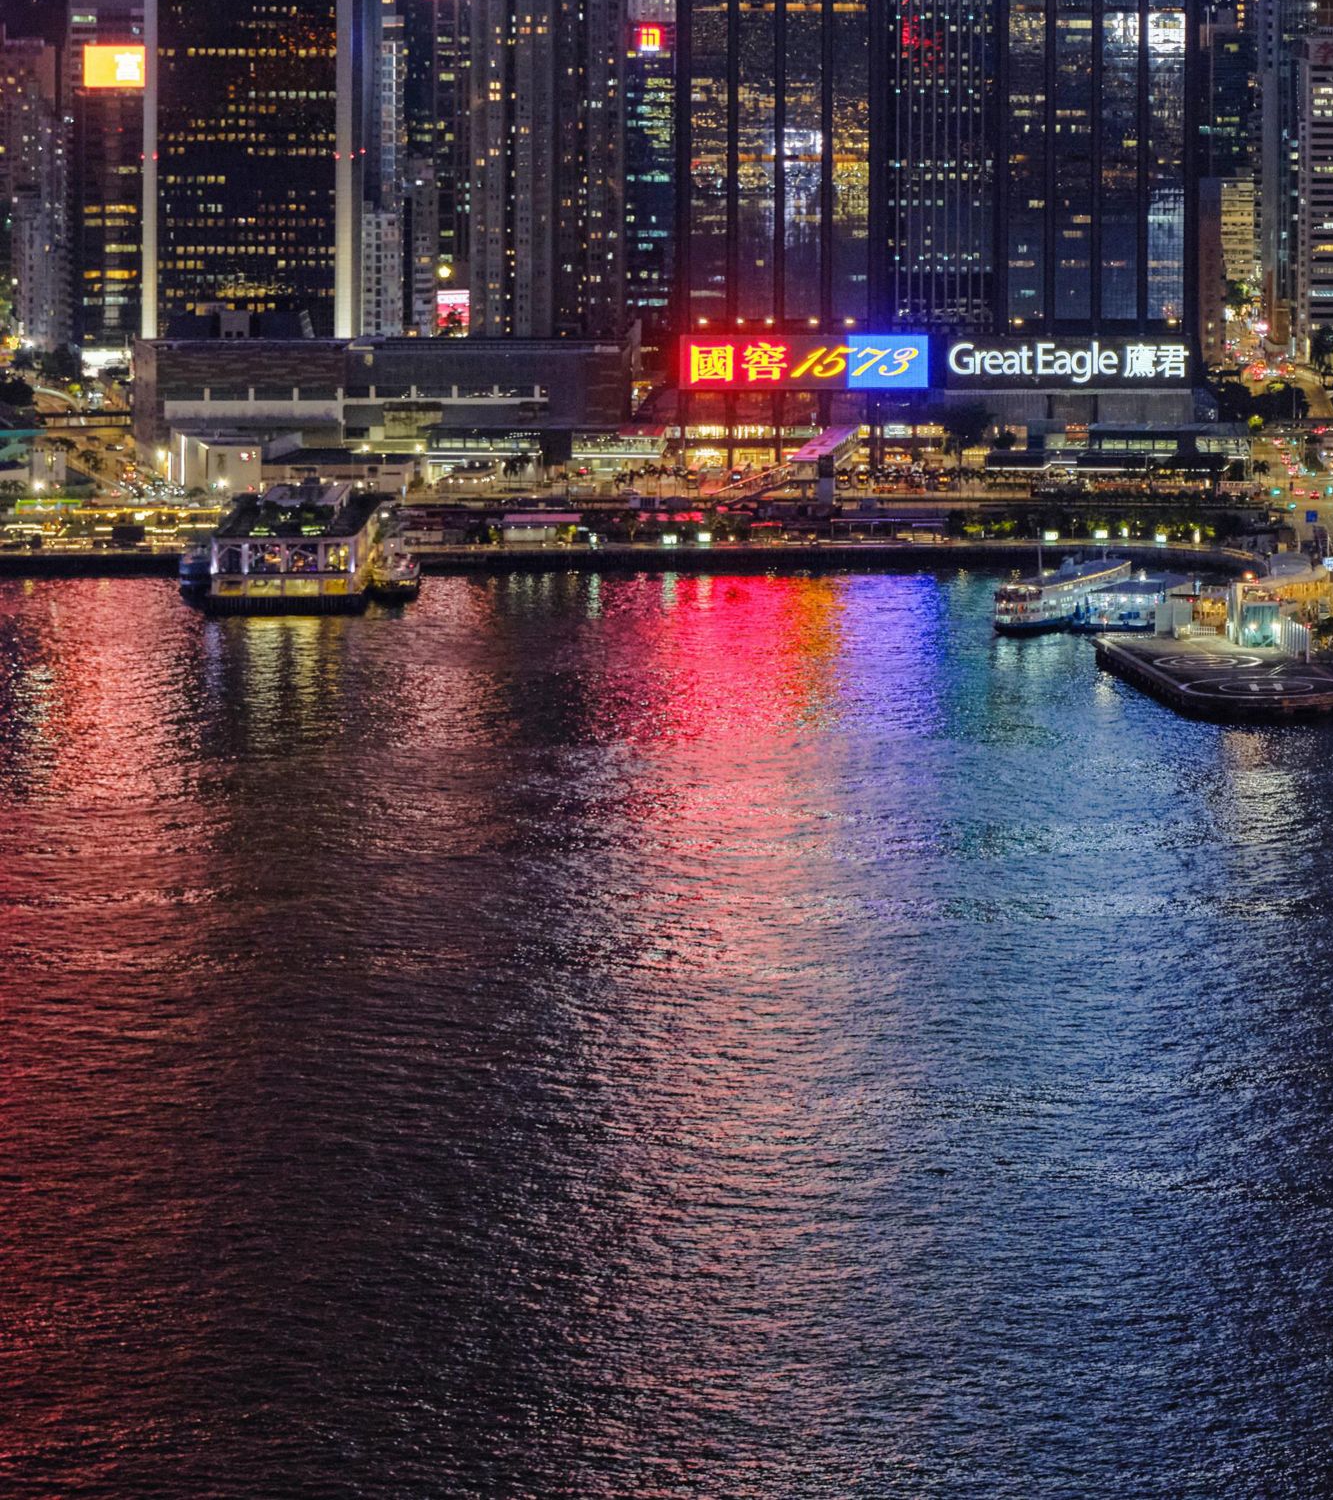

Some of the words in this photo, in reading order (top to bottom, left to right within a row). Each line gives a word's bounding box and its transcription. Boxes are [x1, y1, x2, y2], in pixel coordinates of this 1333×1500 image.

[949, 343, 1033, 376] Great
[1036, 341, 1119, 383] Eagle
[1123, 344, 1190, 378] 鷹君
